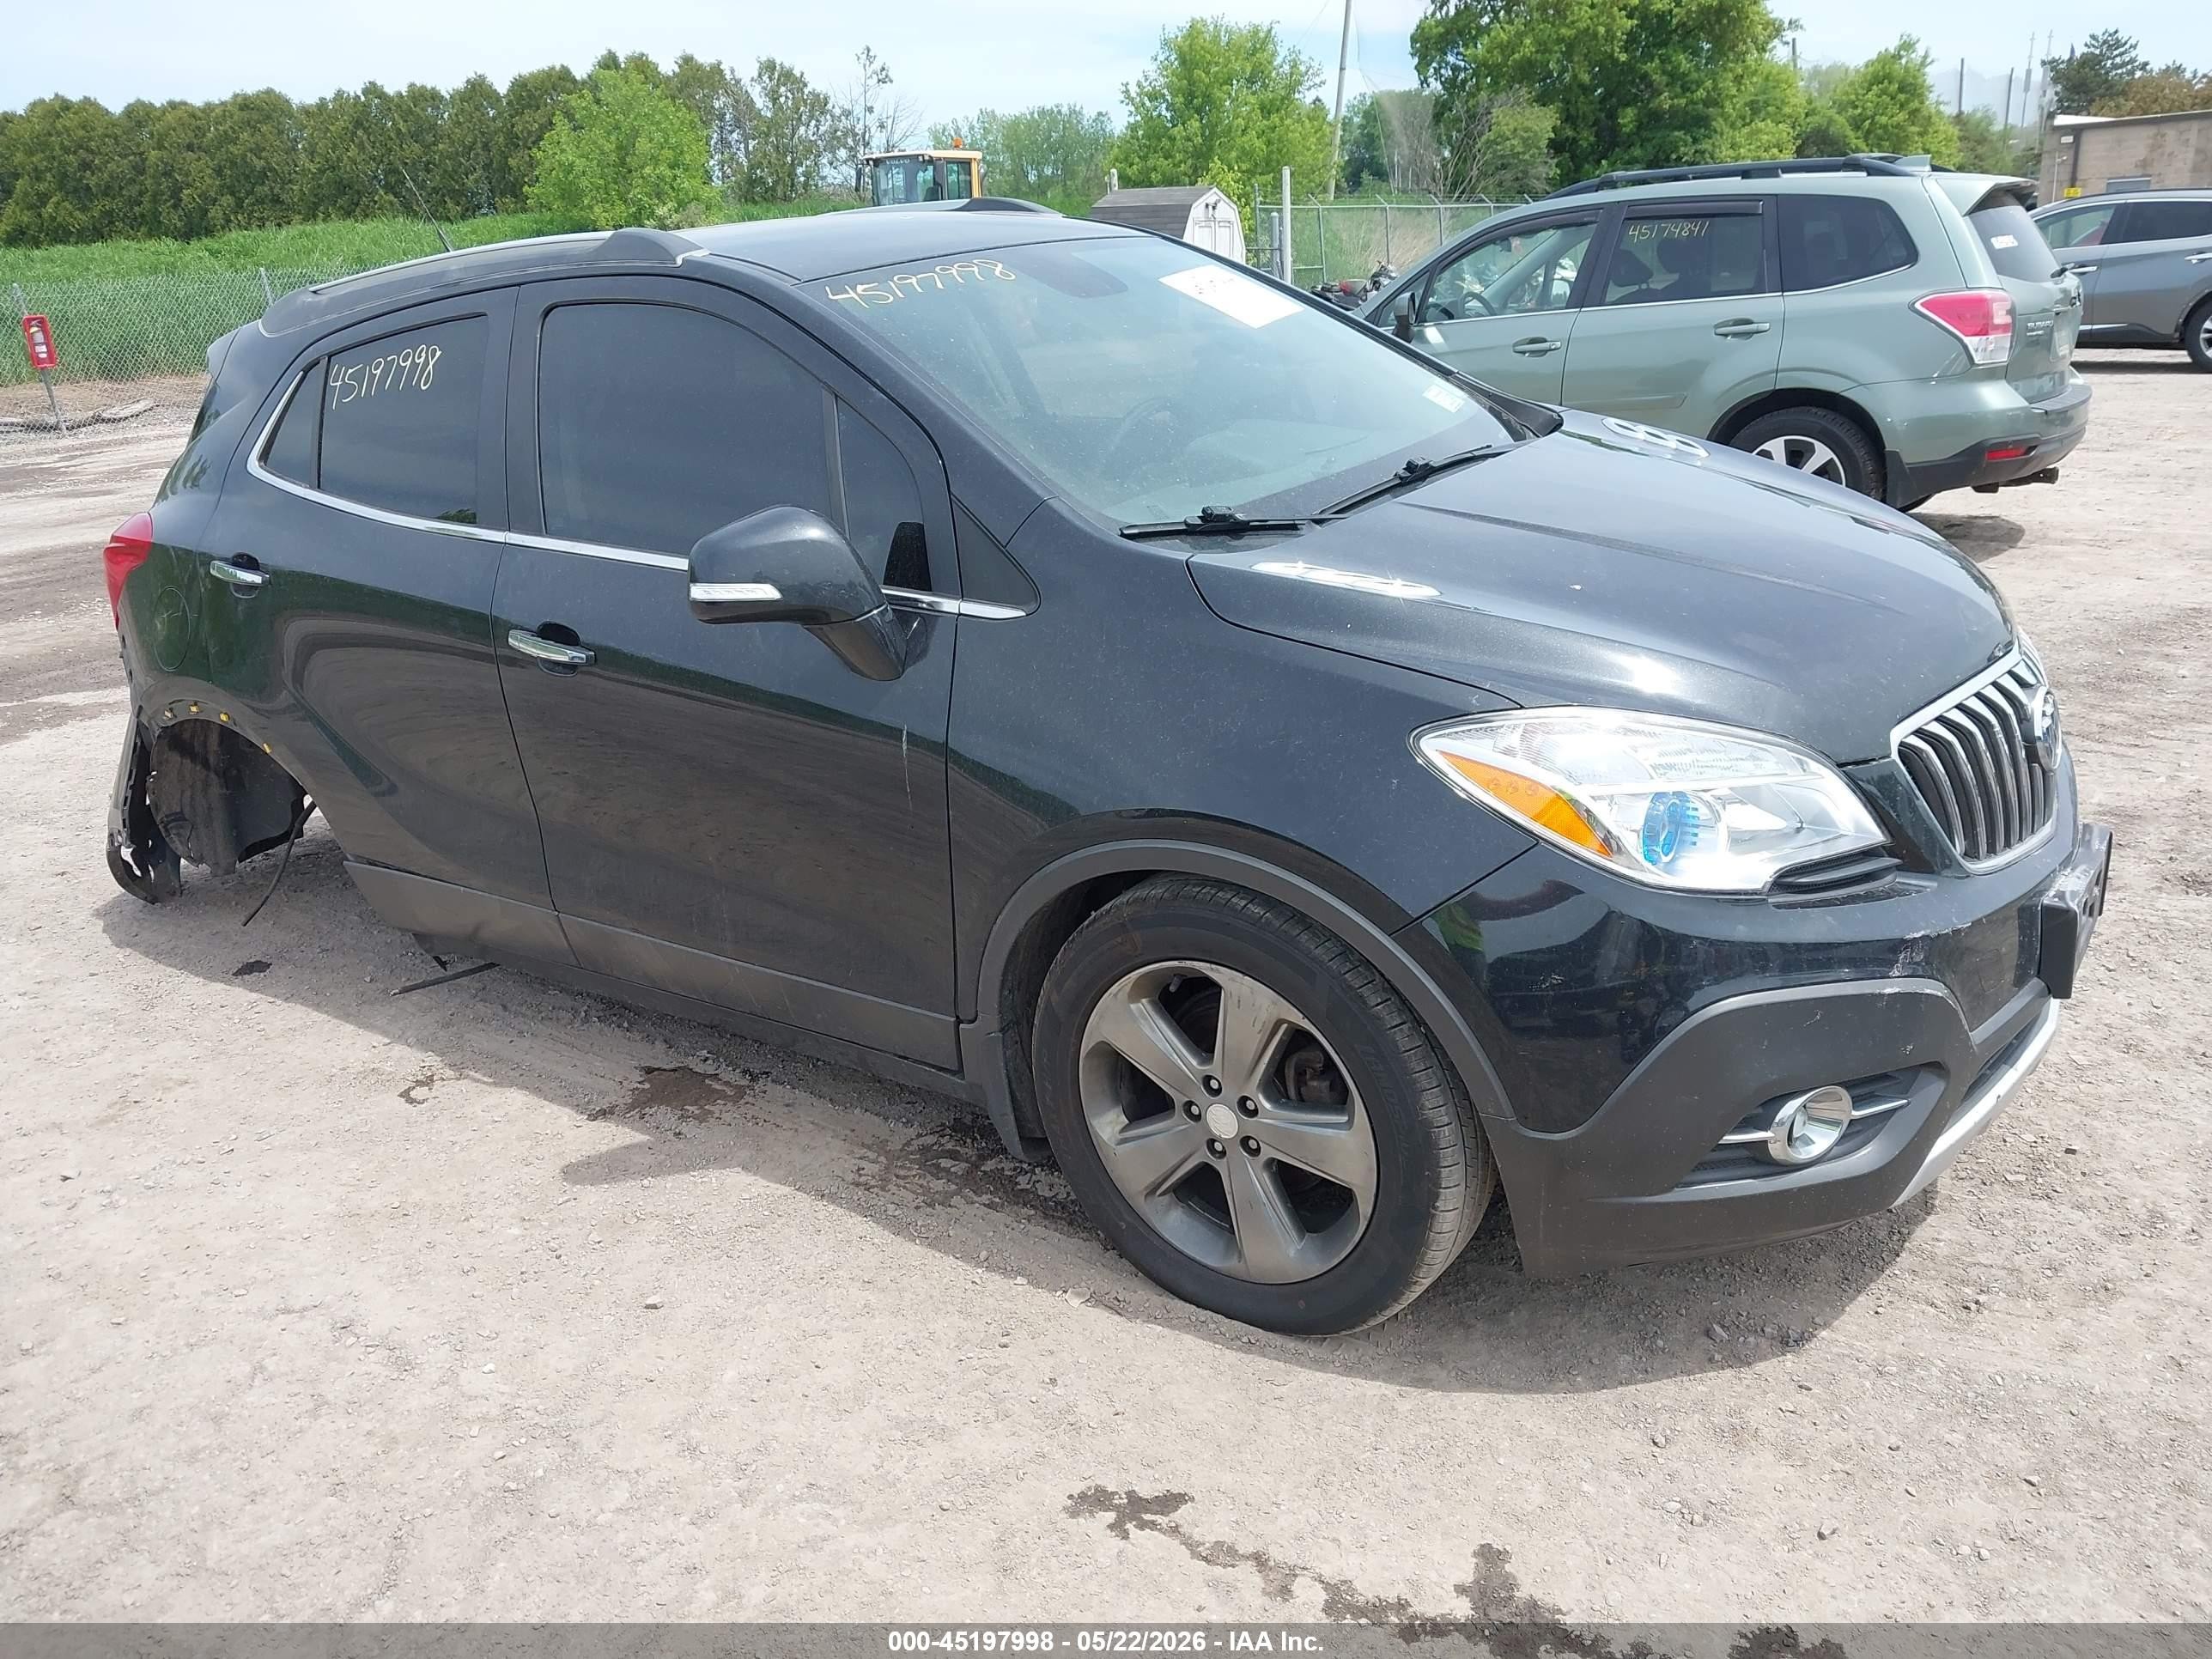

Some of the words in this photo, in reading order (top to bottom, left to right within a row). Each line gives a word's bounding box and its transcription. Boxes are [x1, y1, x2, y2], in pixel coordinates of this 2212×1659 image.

[1628, 220, 1711, 244] 45174841
[824, 258, 1017, 309] 45197998
[329, 343, 443, 410] 45197998
